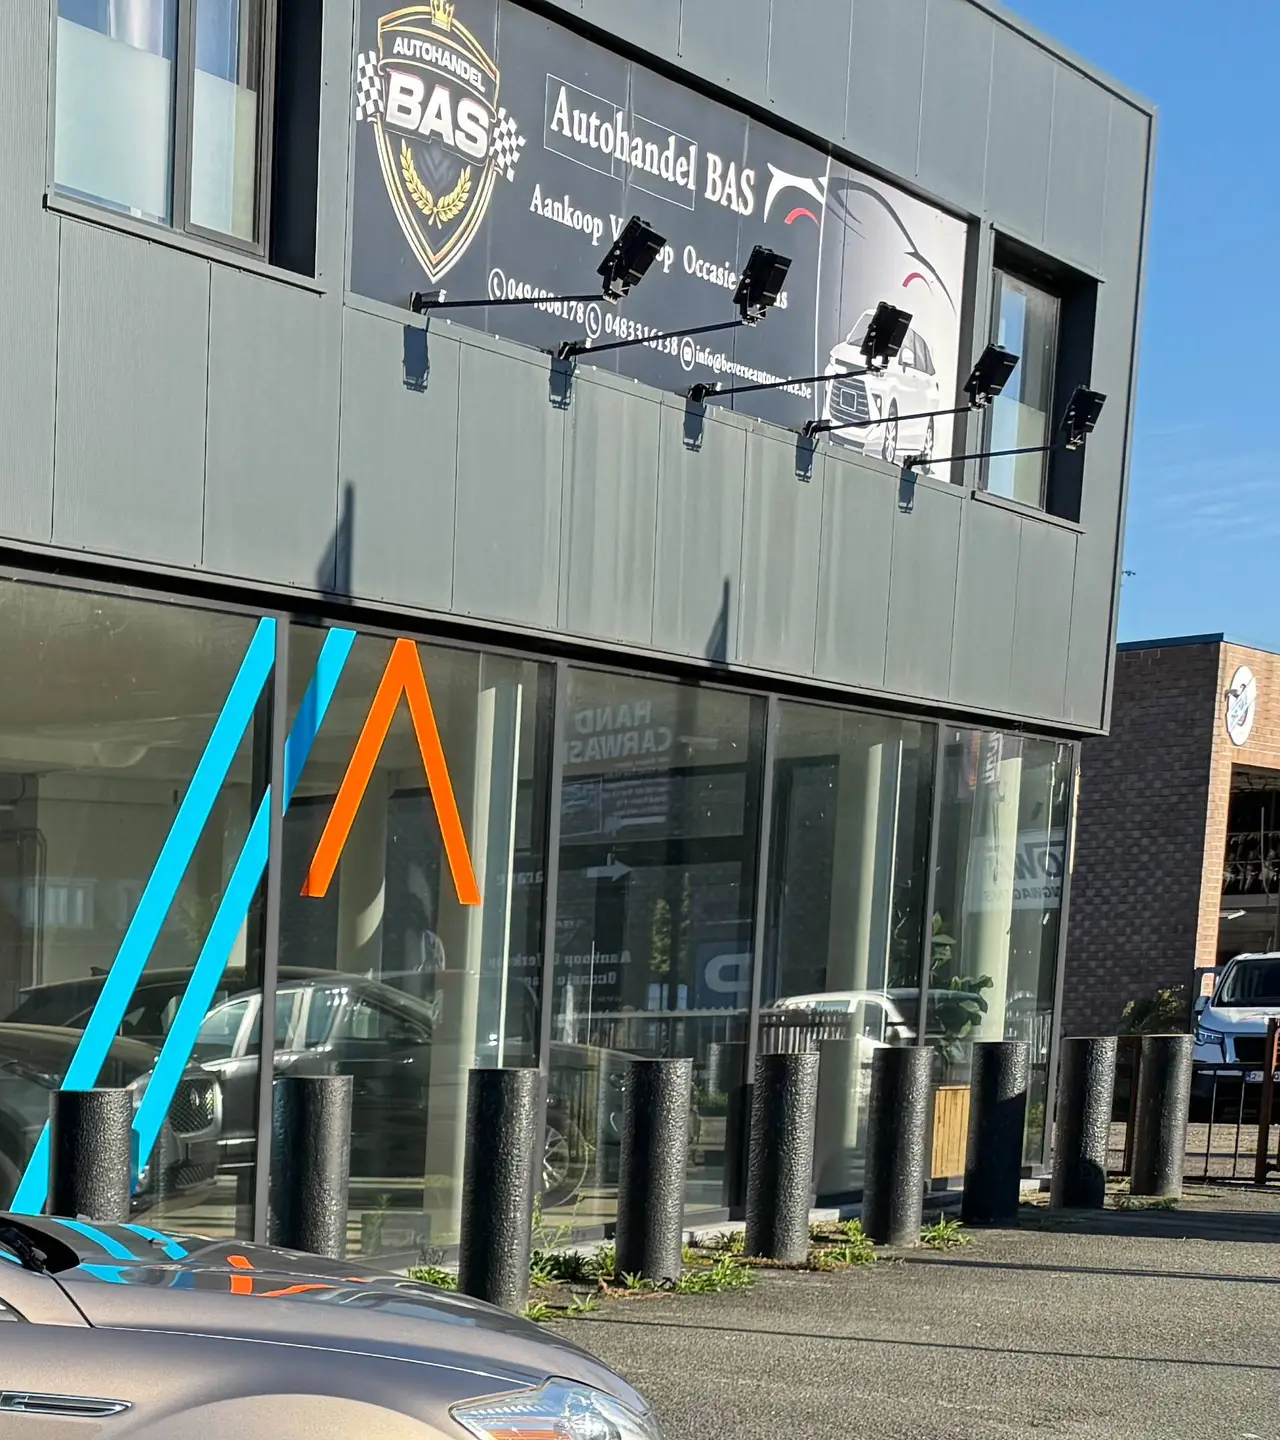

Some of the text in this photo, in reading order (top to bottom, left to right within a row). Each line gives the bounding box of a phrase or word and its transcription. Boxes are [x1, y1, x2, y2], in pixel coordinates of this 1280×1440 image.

[386, 69, 489, 159] BAS
[393, 36, 486, 94] AUTOHANDEL
[550, 85, 755, 217] Autohandel BAS
[529, 183, 604, 246] Aankoop
[683, 245, 737, 291] Occasie
